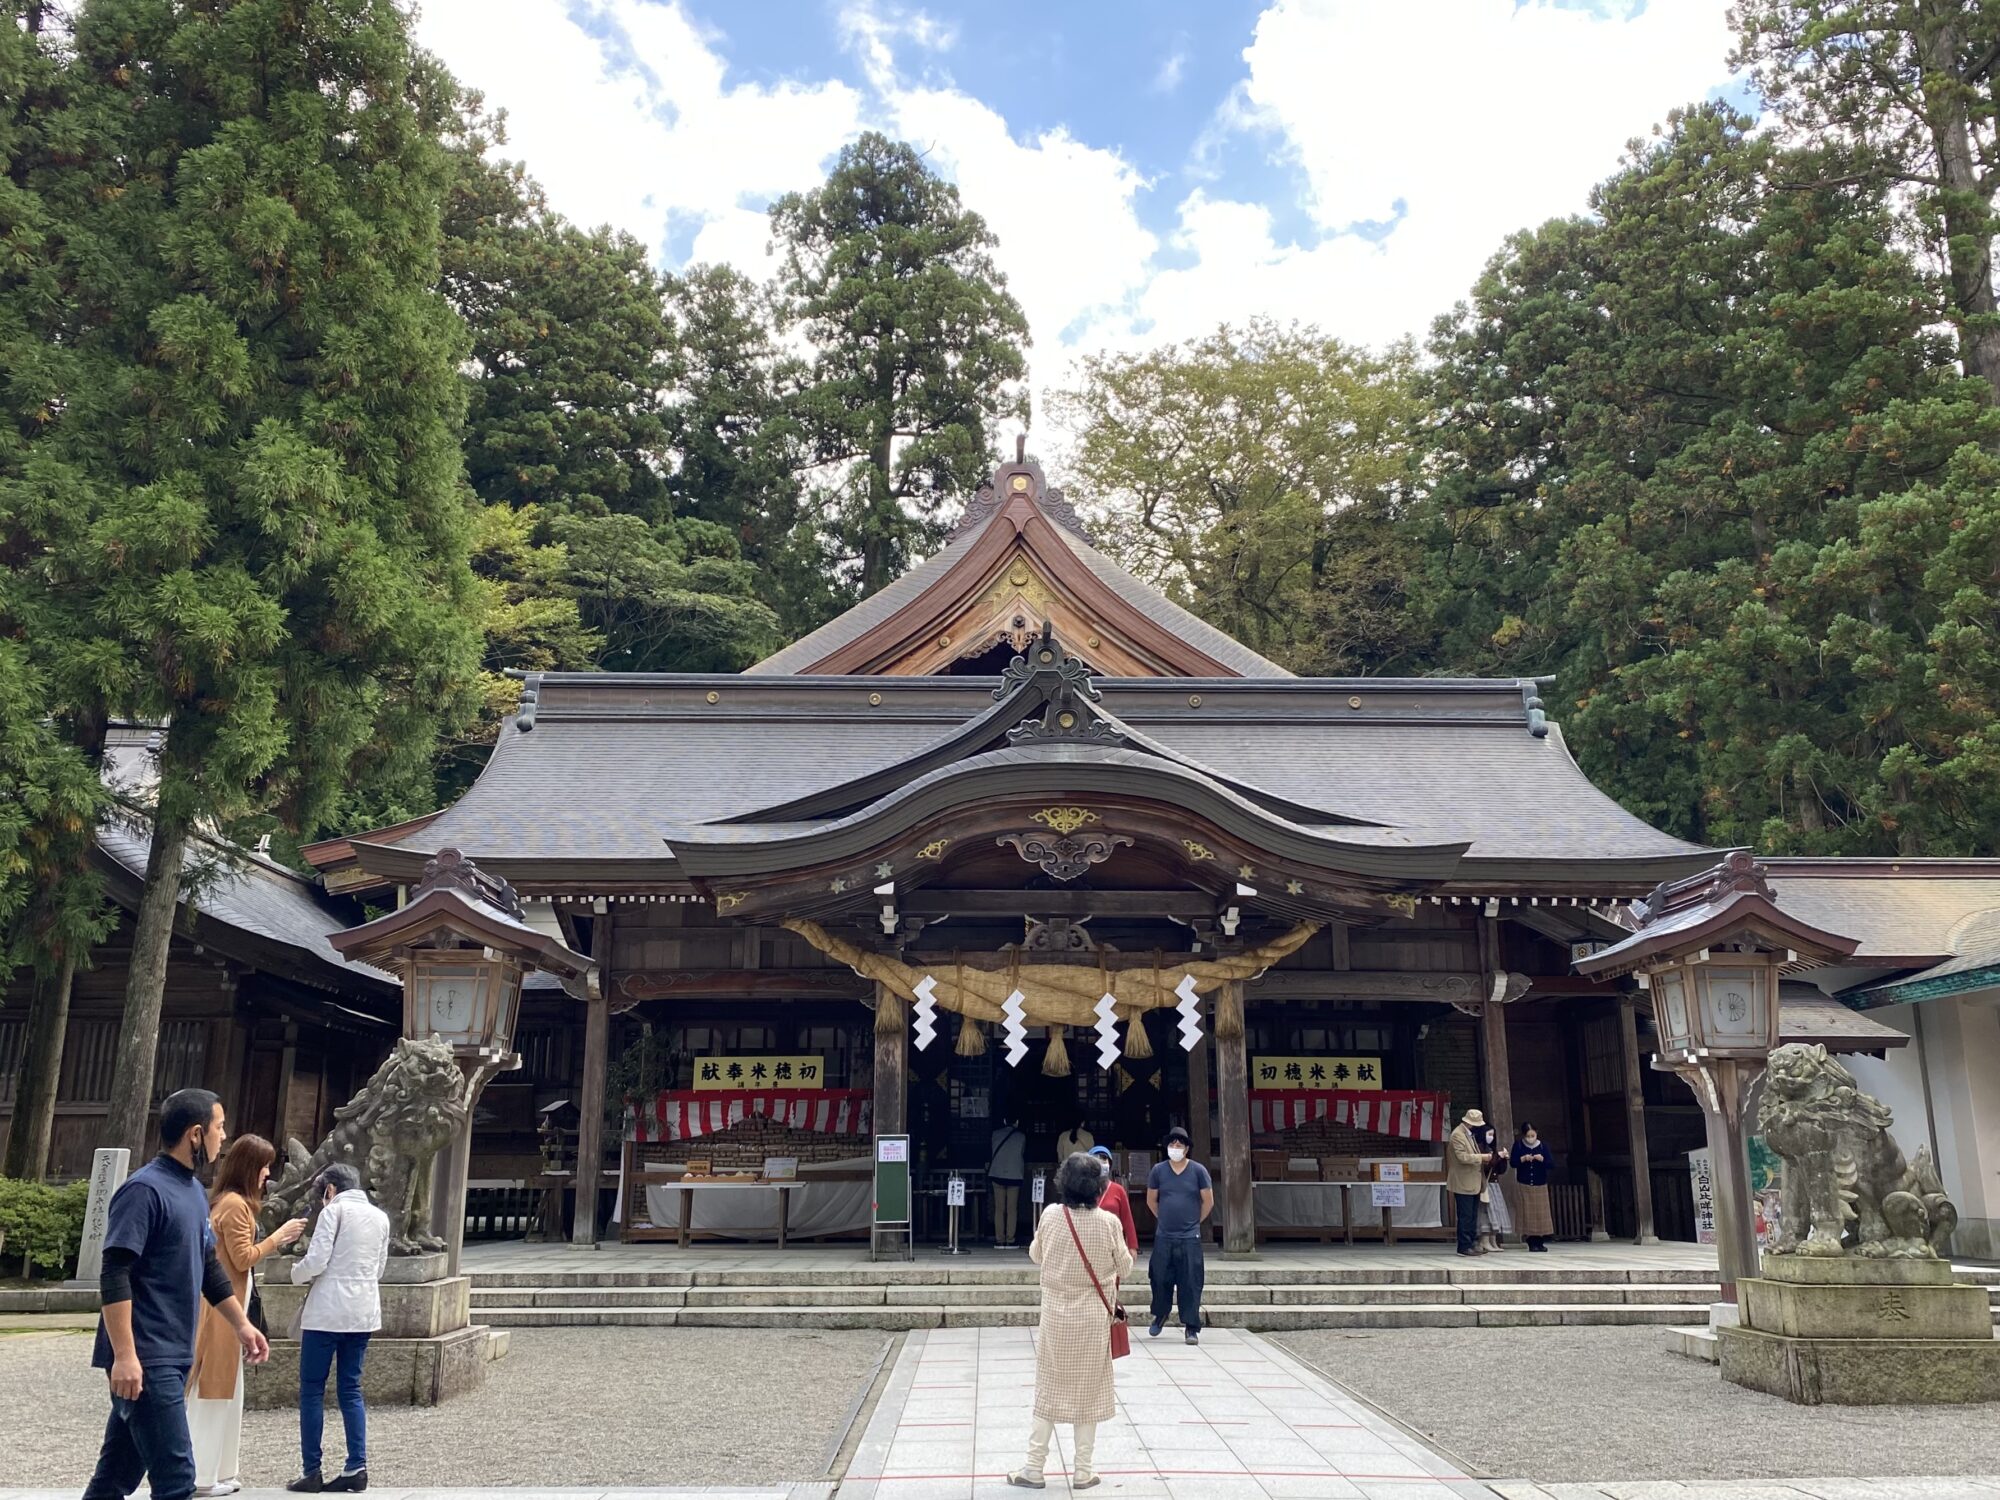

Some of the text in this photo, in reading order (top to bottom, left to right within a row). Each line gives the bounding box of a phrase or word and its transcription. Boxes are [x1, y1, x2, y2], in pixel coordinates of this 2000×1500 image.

[1698, 1175, 1714, 1230] 白山比咩神社
